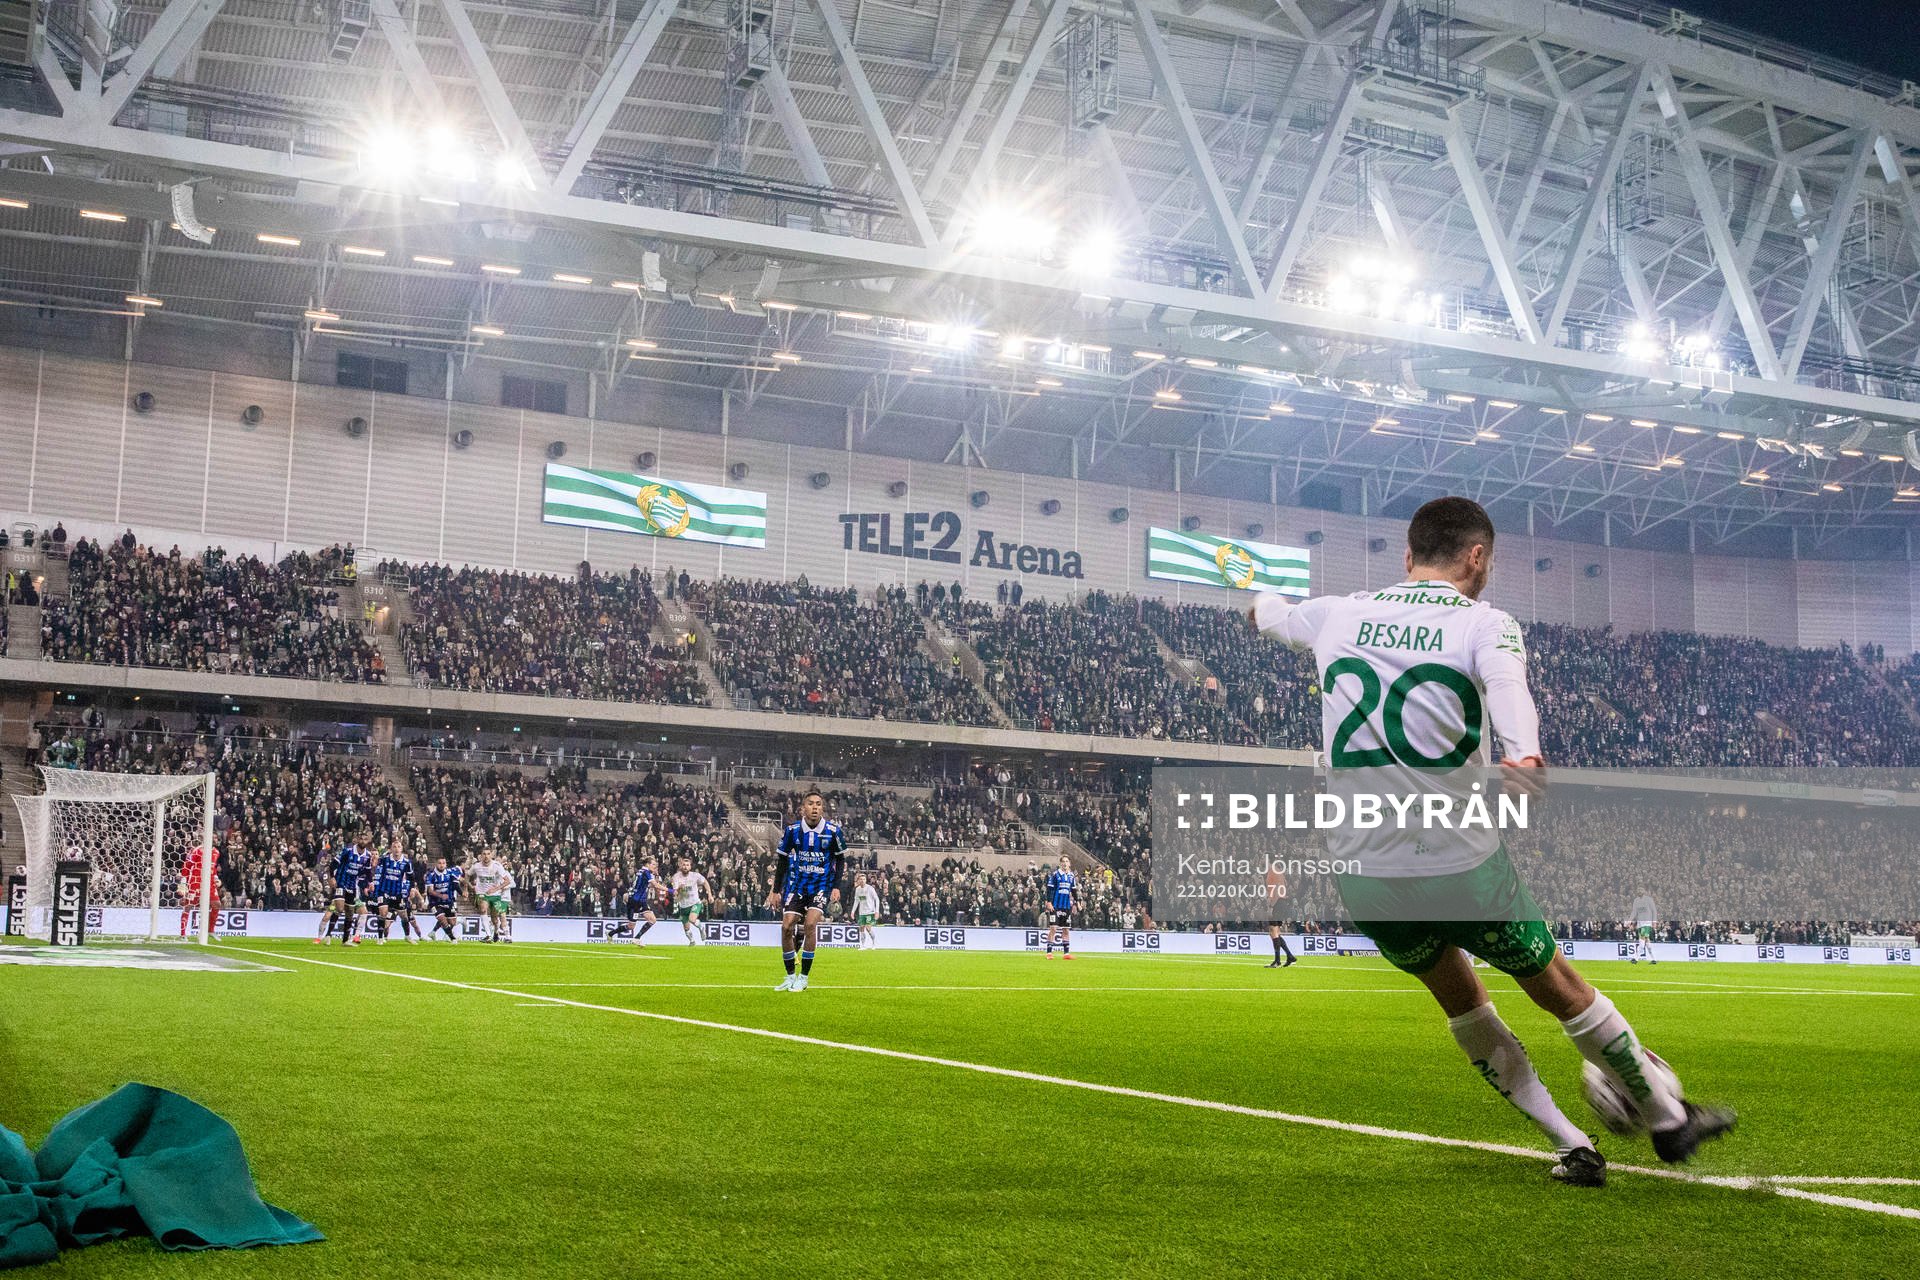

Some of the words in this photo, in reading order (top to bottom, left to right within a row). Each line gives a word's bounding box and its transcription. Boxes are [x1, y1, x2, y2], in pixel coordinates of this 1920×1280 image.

[839, 511, 961, 564] TELE2
[969, 530, 1085, 579] Arena
[363, 586, 384, 595] B310
[1356, 621, 1443, 651] BESARA
[1322, 656, 1482, 776] 20
[57, 874, 83, 946] SELECT
[705, 923, 749, 941] FSG
[817, 926, 860, 943] FSG
[924, 928, 965, 945] FSG
[1122, 932, 1160, 948] FSG
[1215, 935, 1250, 950] FSG
[1303, 936, 1337, 951] FSG
[1688, 945, 1716, 957] FSG
[1757, 946, 1784, 959] FSG
[1823, 947, 1849, 960] FSG
[1886, 949, 1911, 961] FSG
